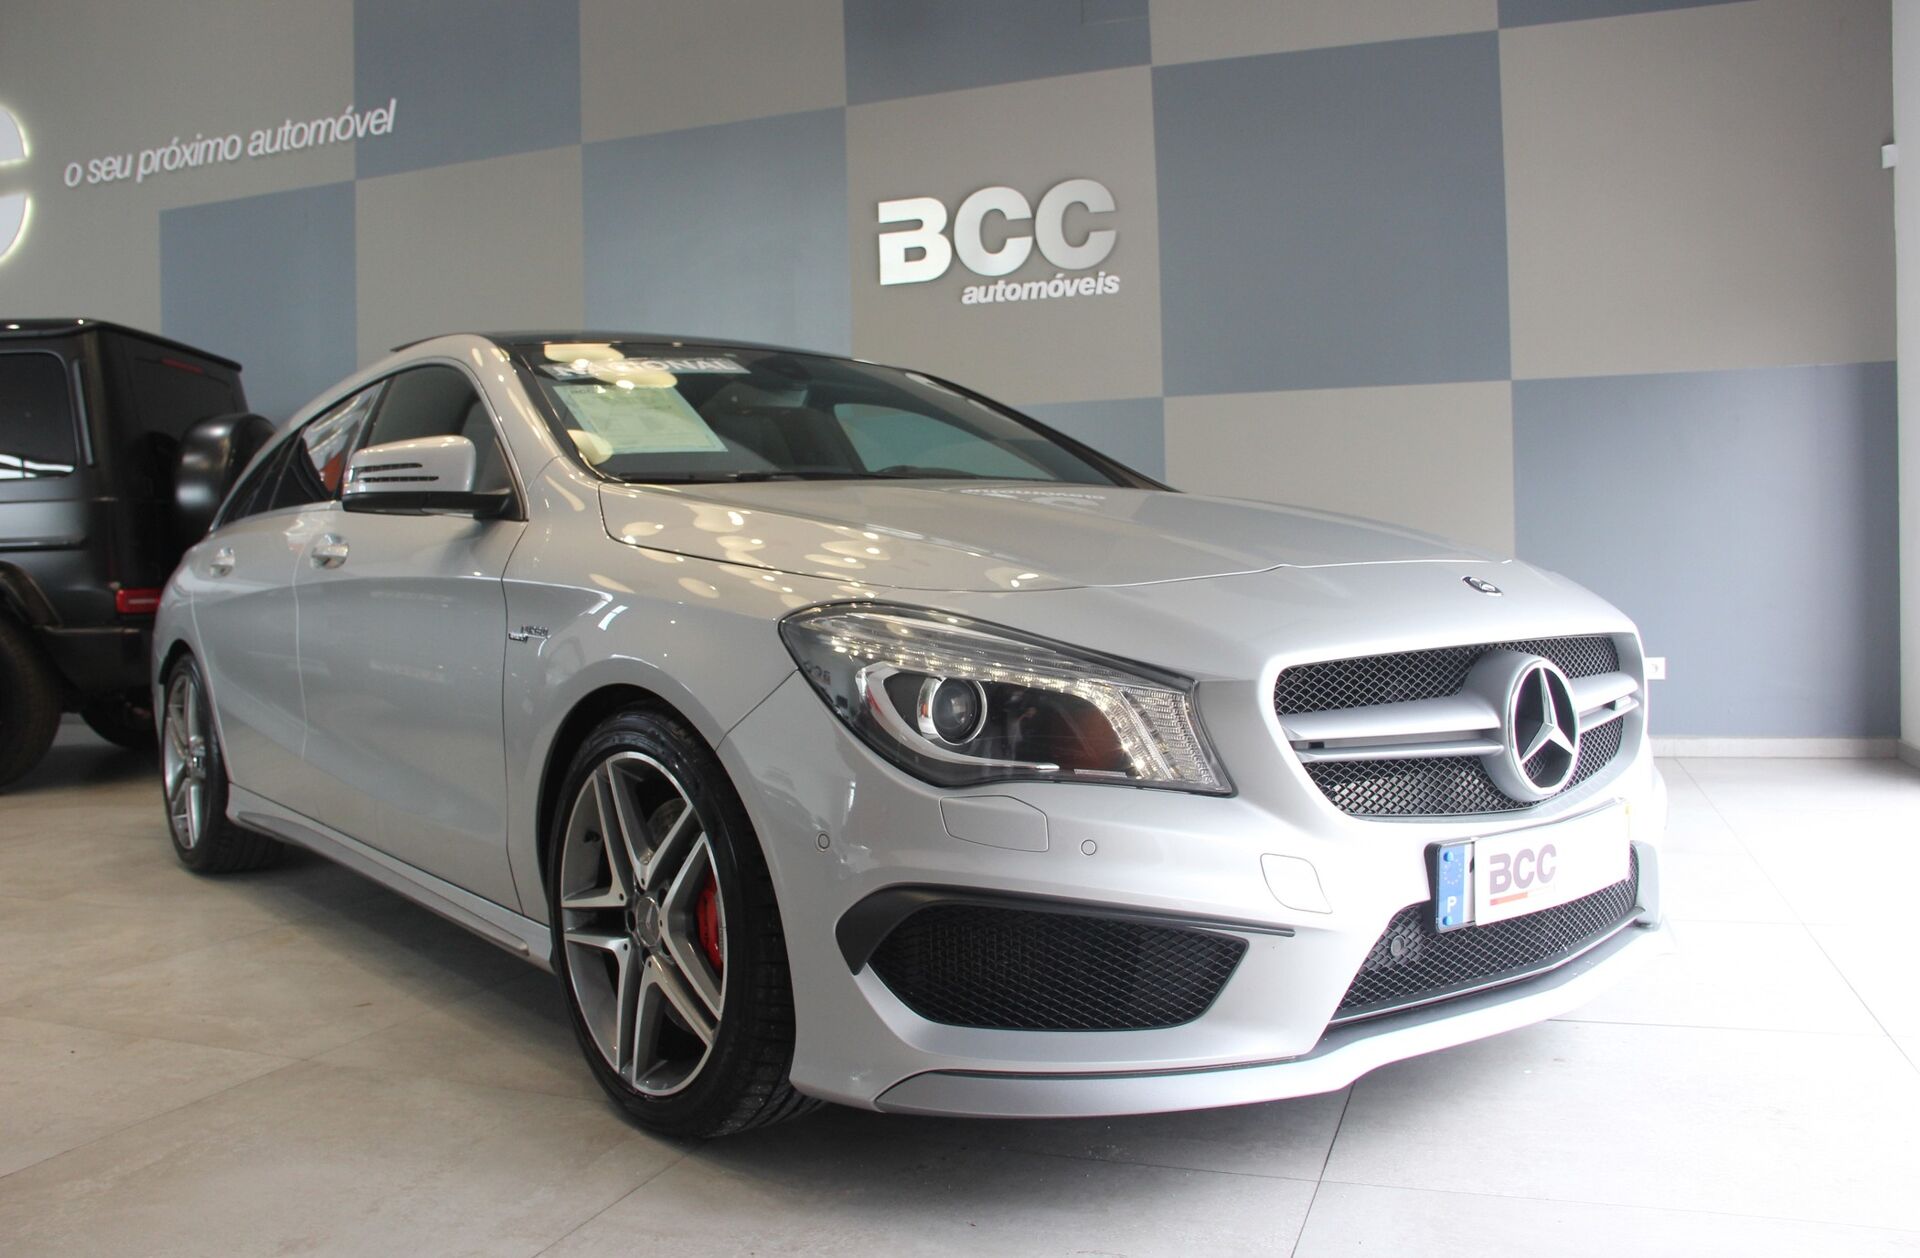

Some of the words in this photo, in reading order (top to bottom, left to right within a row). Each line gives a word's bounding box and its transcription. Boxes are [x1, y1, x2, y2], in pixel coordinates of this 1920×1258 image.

[64, 161, 83, 187] o
[87, 154, 132, 184] seu
[136, 133, 242, 184] próximo
[247, 98, 397, 157] automóvel
[878, 178, 1117, 286] BCC
[961, 271, 1120, 305] automóveis
[1490, 843, 1557, 895] BCC
[1447, 895, 1458, 914] P
